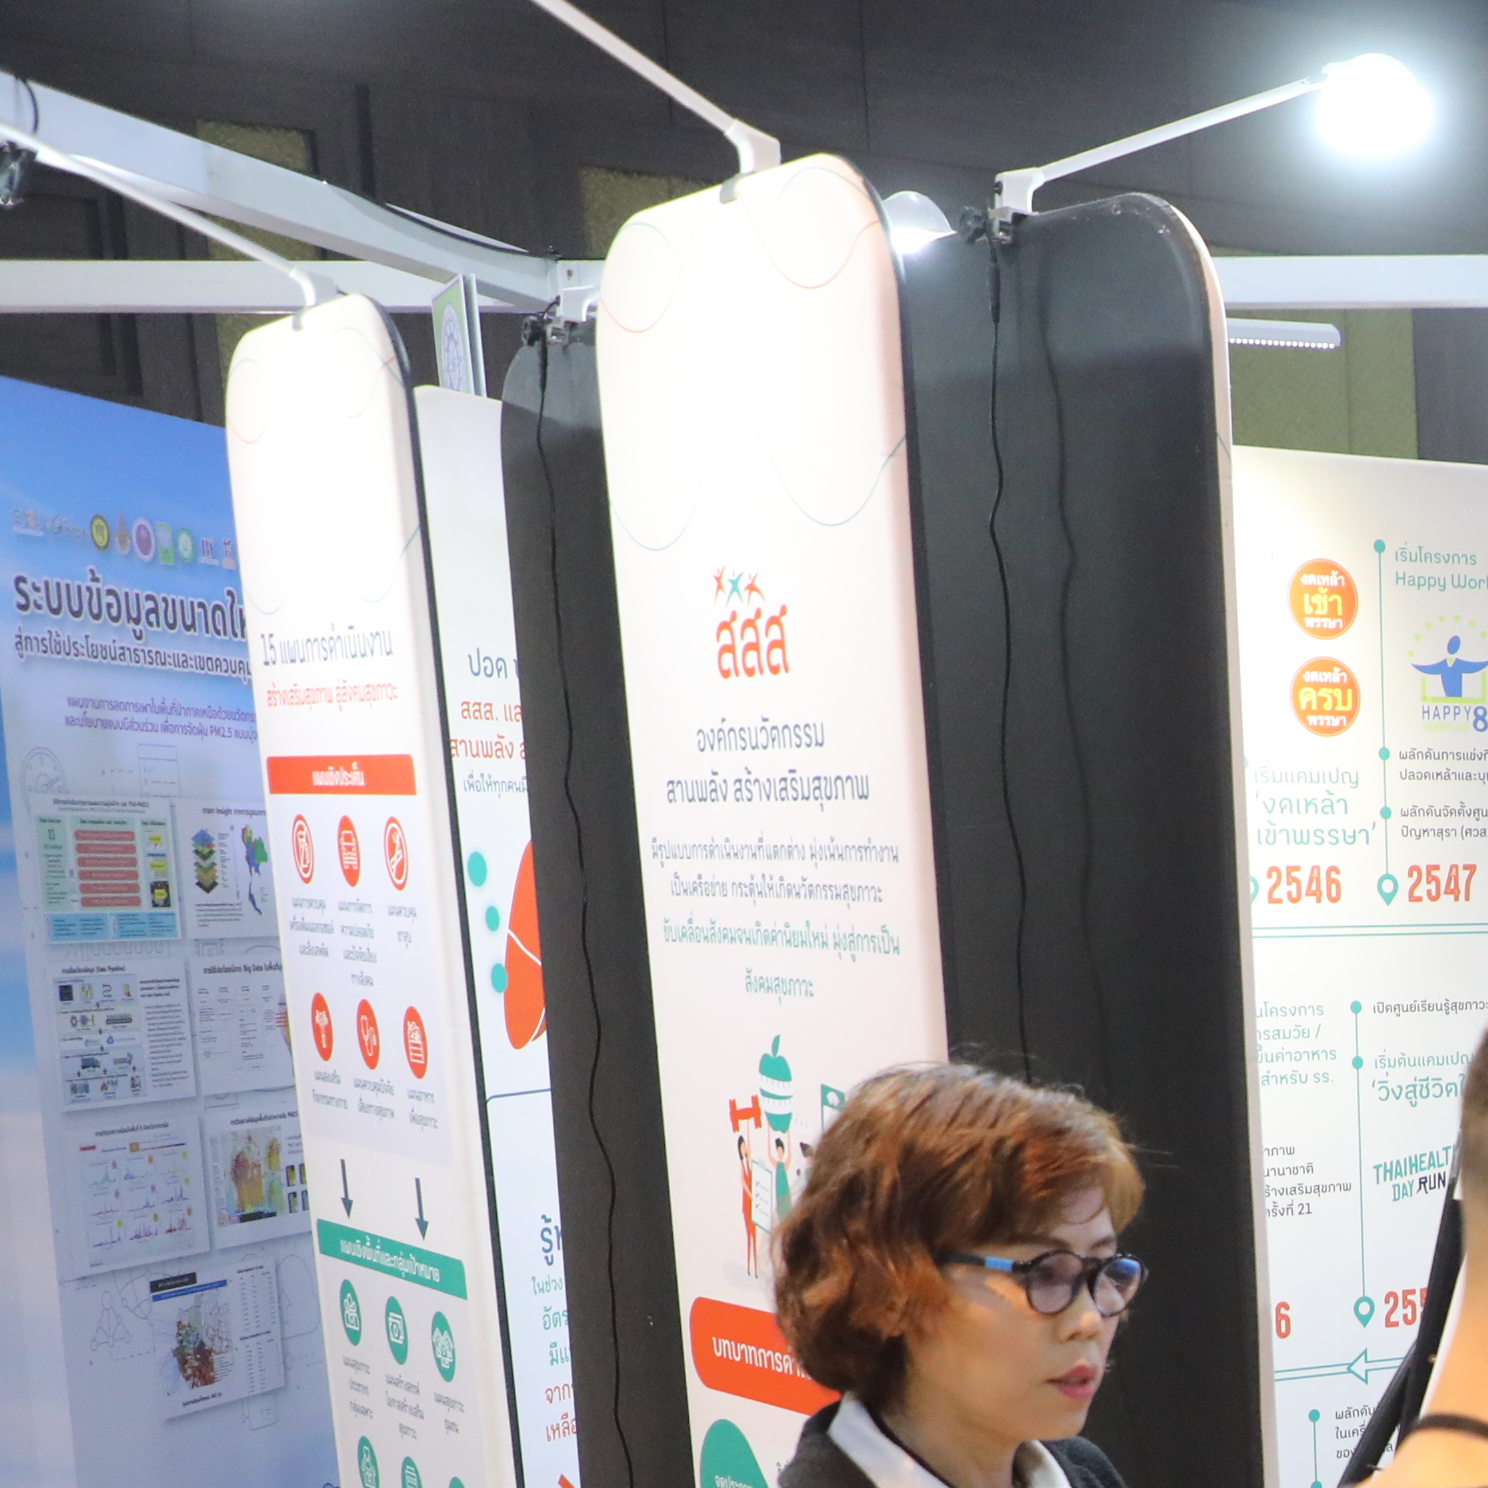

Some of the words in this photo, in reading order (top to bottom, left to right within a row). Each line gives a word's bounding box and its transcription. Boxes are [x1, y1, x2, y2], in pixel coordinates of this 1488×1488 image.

[1394, 541, 1477, 566] เริ่มโครงการ
[1300, 572, 1345, 588] งดเหล้า
[1395, 571, 1446, 592] Happy
[1303, 587, 1343, 616] เข้า
[1304, 614, 1343, 630] พรรษา
[261, 633, 277, 666] 15
[715, 604, 790, 679] สสส
[468, 648, 508, 679] ปอด
[1302, 668, 1347, 684] งดเหล้า
[461, 701, 498, 721] สสส.
[1298, 685, 1353, 713] ครบ
[1307, 712, 1347, 728] พรรษา
[1421, 703, 1471, 721] HAPPY
[1471, 705, 1488, 732] 8
[450, 734, 514, 760] สานพลัง
[697, 715, 824, 753] องค์กรนวัตกรรม
[667, 770, 728, 804] สานพลัง
[733, 768, 870, 812] สร้างเสริมสุขภาพ
[1401, 822, 1457, 845] ปัญหาสุรา
[1266, 864, 1342, 904] 2546
[1408, 862, 1478, 902] 2547
[1373, 999, 1488, 1017] เปิดศูนย์เรียนรู้สุขภาวะ
[1261, 1069, 1308, 1086] สำหรับ
[1392, 1179, 1415, 1202] DAY
[1416, 1170, 1447, 1195] RUN
[1297, 1202, 1313, 1216] 21
